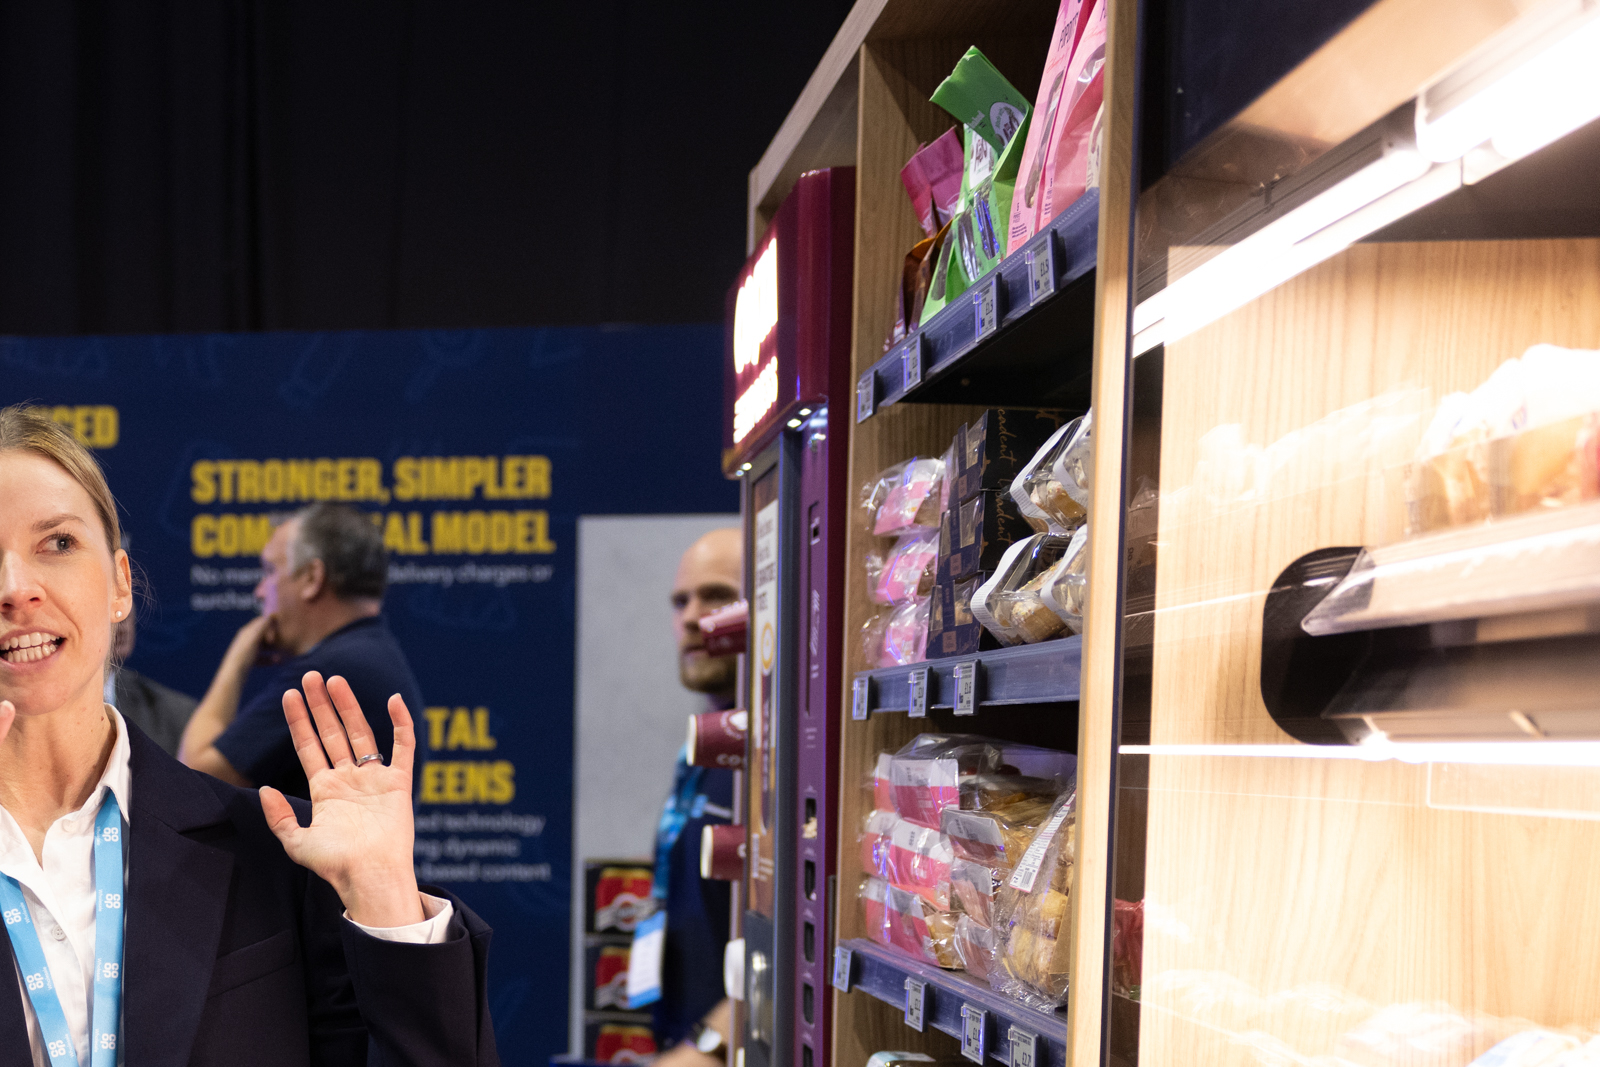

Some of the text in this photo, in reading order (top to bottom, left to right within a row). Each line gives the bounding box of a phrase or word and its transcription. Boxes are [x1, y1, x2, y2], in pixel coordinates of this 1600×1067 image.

[191, 455, 552, 505] STRONGER, SIMPLER
[431, 510, 557, 555] MODEL
